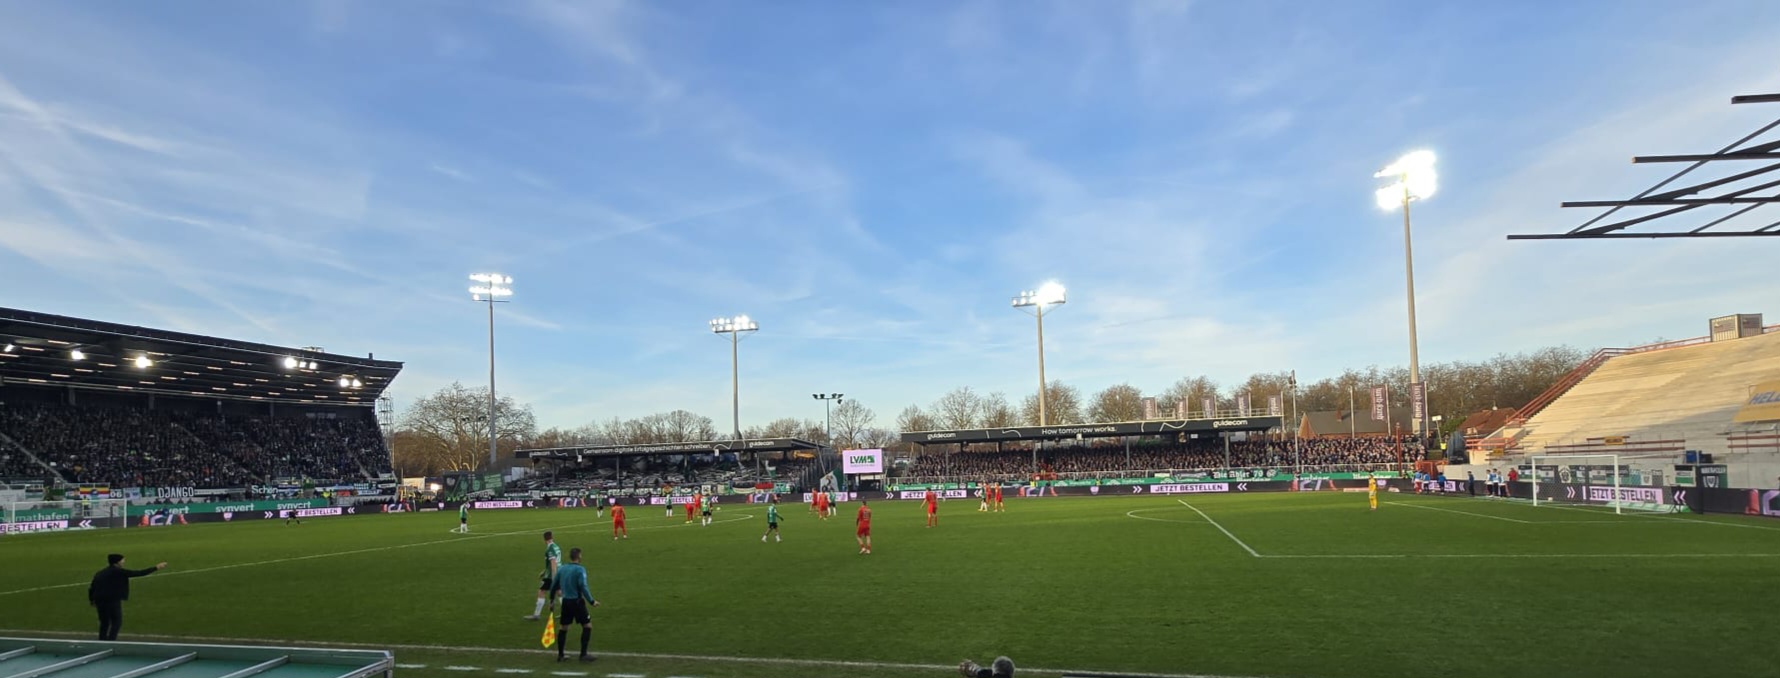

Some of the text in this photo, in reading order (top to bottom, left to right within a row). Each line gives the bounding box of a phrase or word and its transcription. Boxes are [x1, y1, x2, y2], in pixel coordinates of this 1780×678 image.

[1213, 419, 1248, 430] guidecom
[1059, 426, 1093, 434] tomorrow
[1094, 425, 1117, 433] works.
[927, 432, 957, 441] guidecom
[850, 456, 868, 464] LVM
[1180, 483, 1223, 491] BESTELLEN
[158, 487, 195, 499] DJANGO
[1590, 488, 1609, 499] ETZT
[215, 503, 255, 513] synvert
[277, 501, 312, 510] synvert
